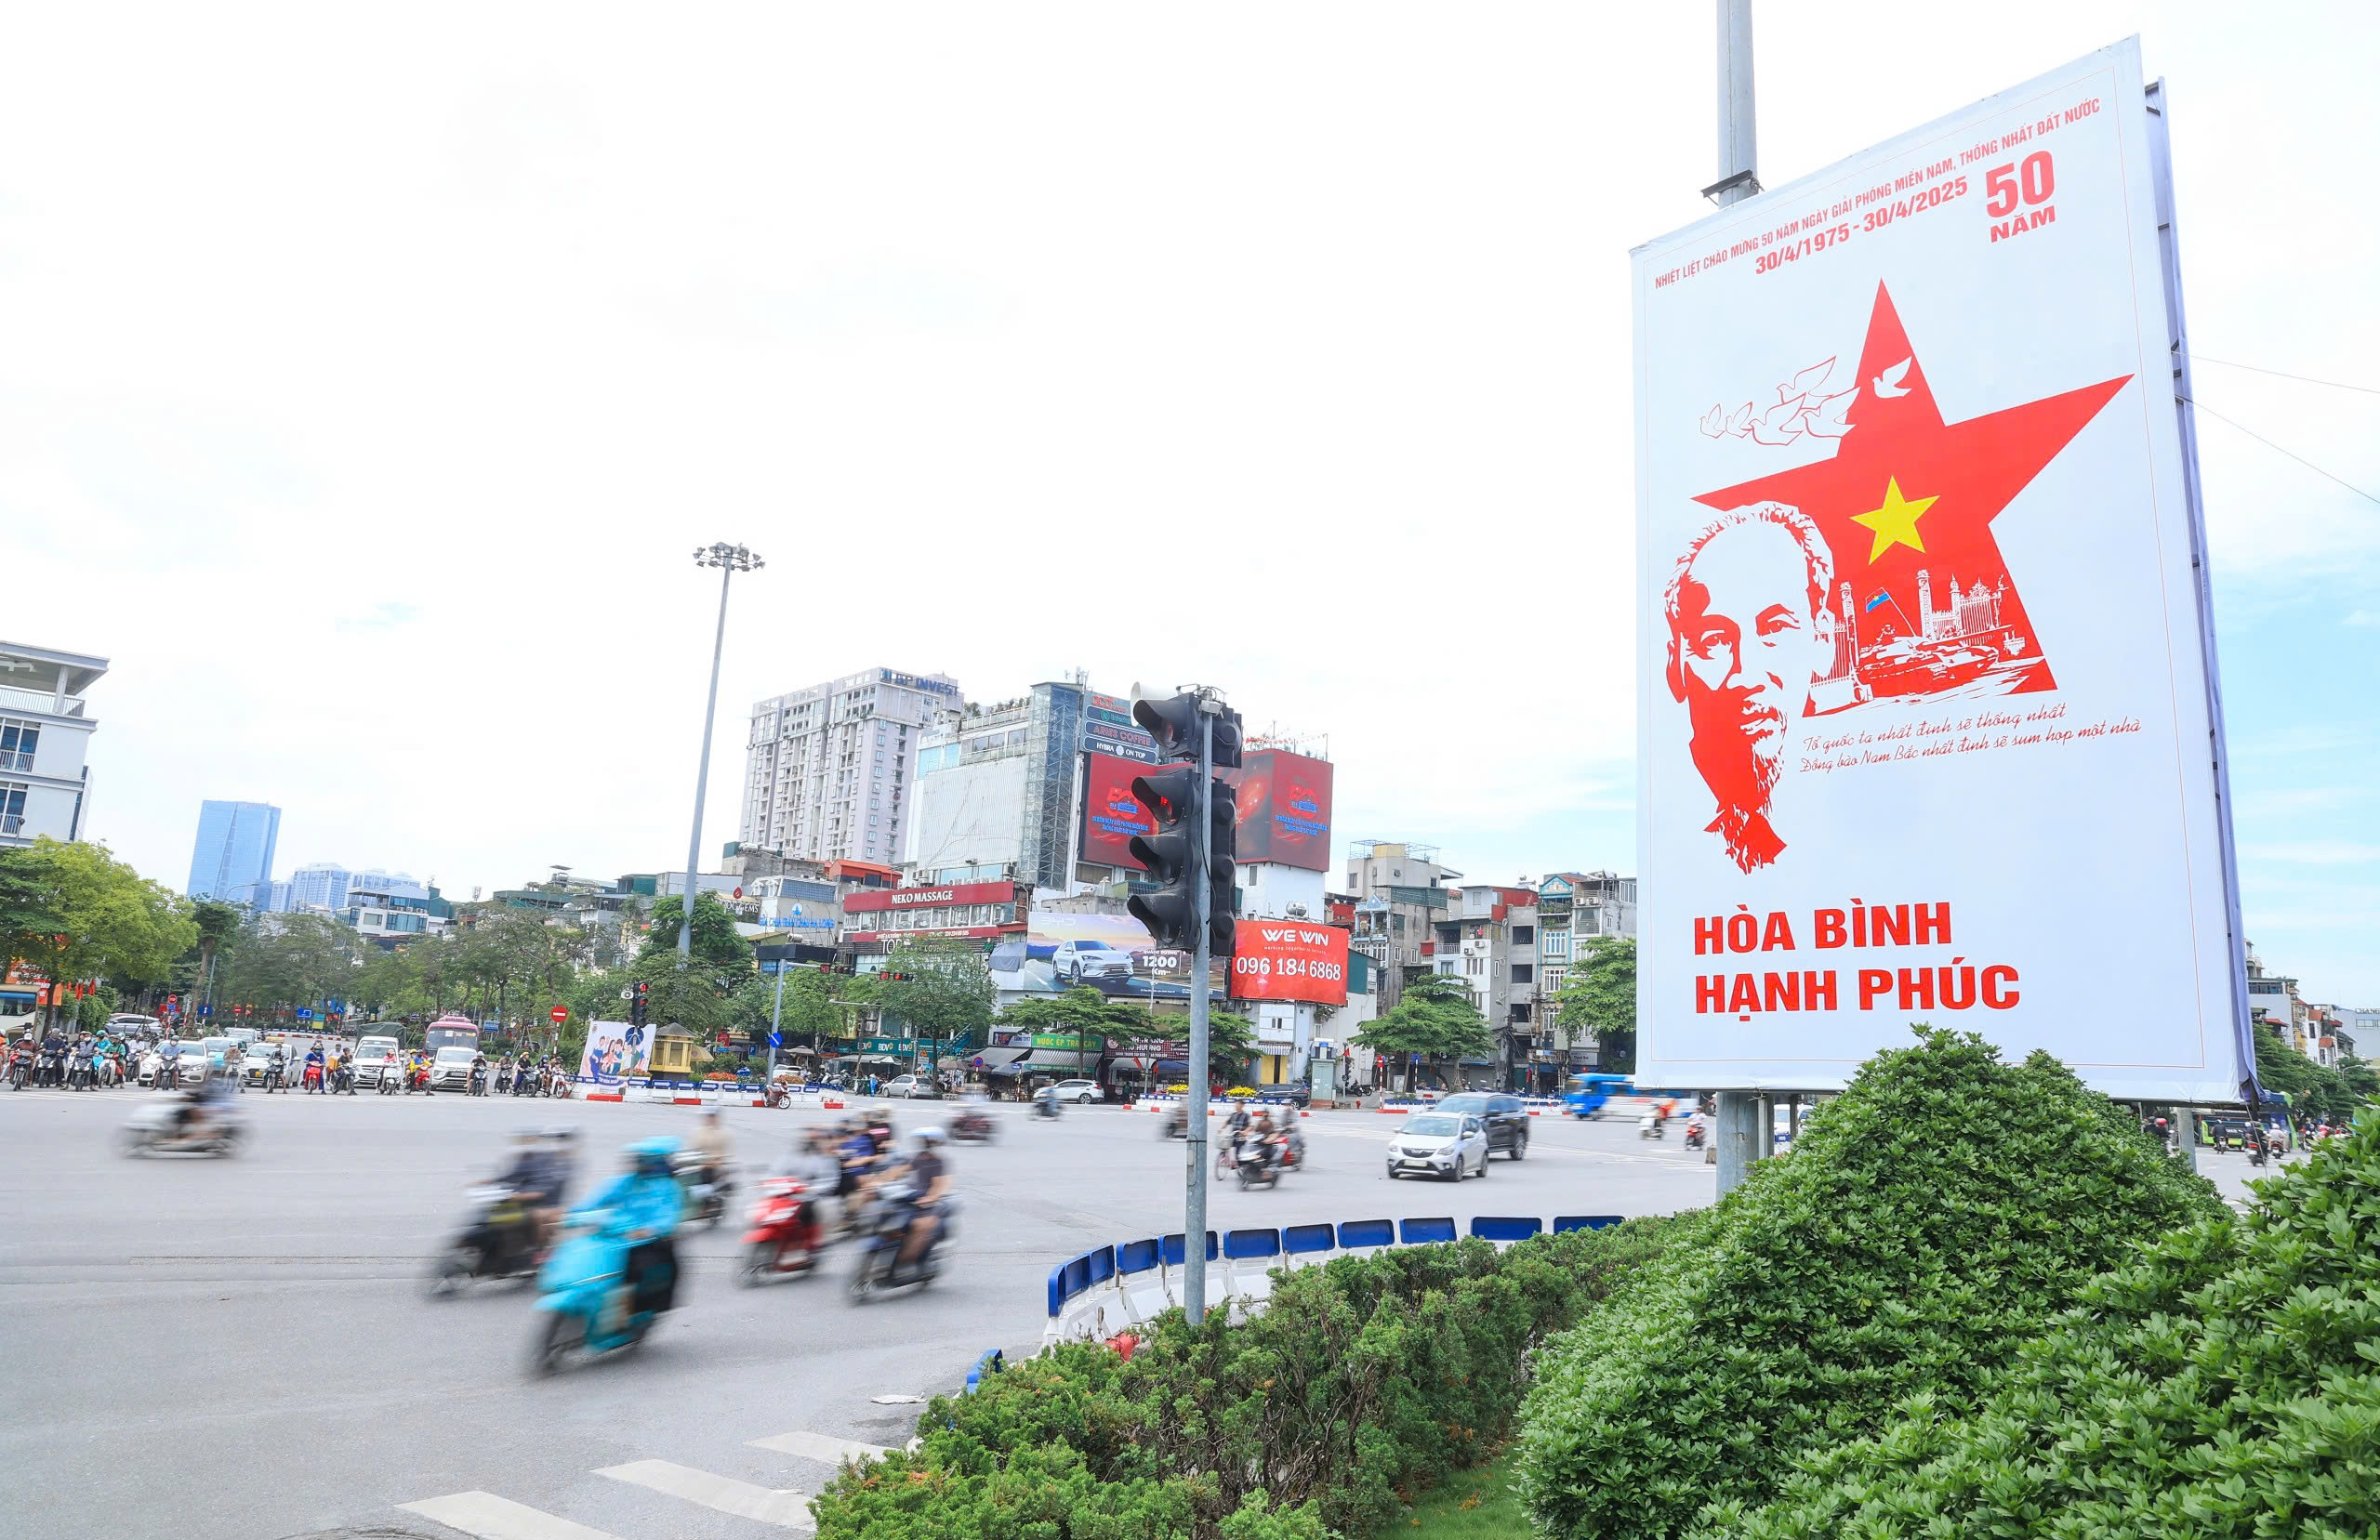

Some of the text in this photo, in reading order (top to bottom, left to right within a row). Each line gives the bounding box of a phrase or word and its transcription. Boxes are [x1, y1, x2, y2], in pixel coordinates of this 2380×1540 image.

[1655, 268, 1680, 289] NHIỆT
[1683, 259, 1700, 277] LIỆT
[1703, 246, 1728, 270] CHÀO
[1731, 236, 1759, 259] MỪNG
[1761, 231, 1774, 247] 50
[1776, 220, 1799, 241] NĂM
[1802, 209, 1829, 230] NGÀY
[1831, 196, 1853, 218] GIẢI
[1856, 182, 1892, 209] PHÓNG
[1895, 167, 1924, 193] MIỀN
[1959, 141, 1998, 166] THỐNG
[2002, 122, 2033, 150] NHẤT
[2037, 111, 2060, 137] ĐẤT
[2065, 97, 2100, 125] NƯỚC
[1986, 150, 2056, 218] 50
[1755, 222, 1850, 274] 30/4/1975
[1863, 175, 1968, 232] 30/4/2025
[1990, 204, 2056, 243] NĂM
[1119, 731, 1151, 746] COFFEE
[1800, 716, 2141, 774] Đồng bào Nam Bắc nhất định sẽ sum họp một nhà
[1804, 702, 2067, 754] Tổ quốc ta nhất định sẽ thống nhất
[1125, 748, 1134, 757] ON
[1135, 750, 1146, 759] TOP
[892, 889, 953, 904] NEKO MASSAGE
[1262, 929, 1329, 946] WE WIN
[1694, 898, 1951, 955] HÒA BÌNH
[1143, 955, 1177, 968] 1200
[1236, 956, 1342, 981] 096 184 6868
[1696, 957, 2020, 1021] HẠNH PHÚC
